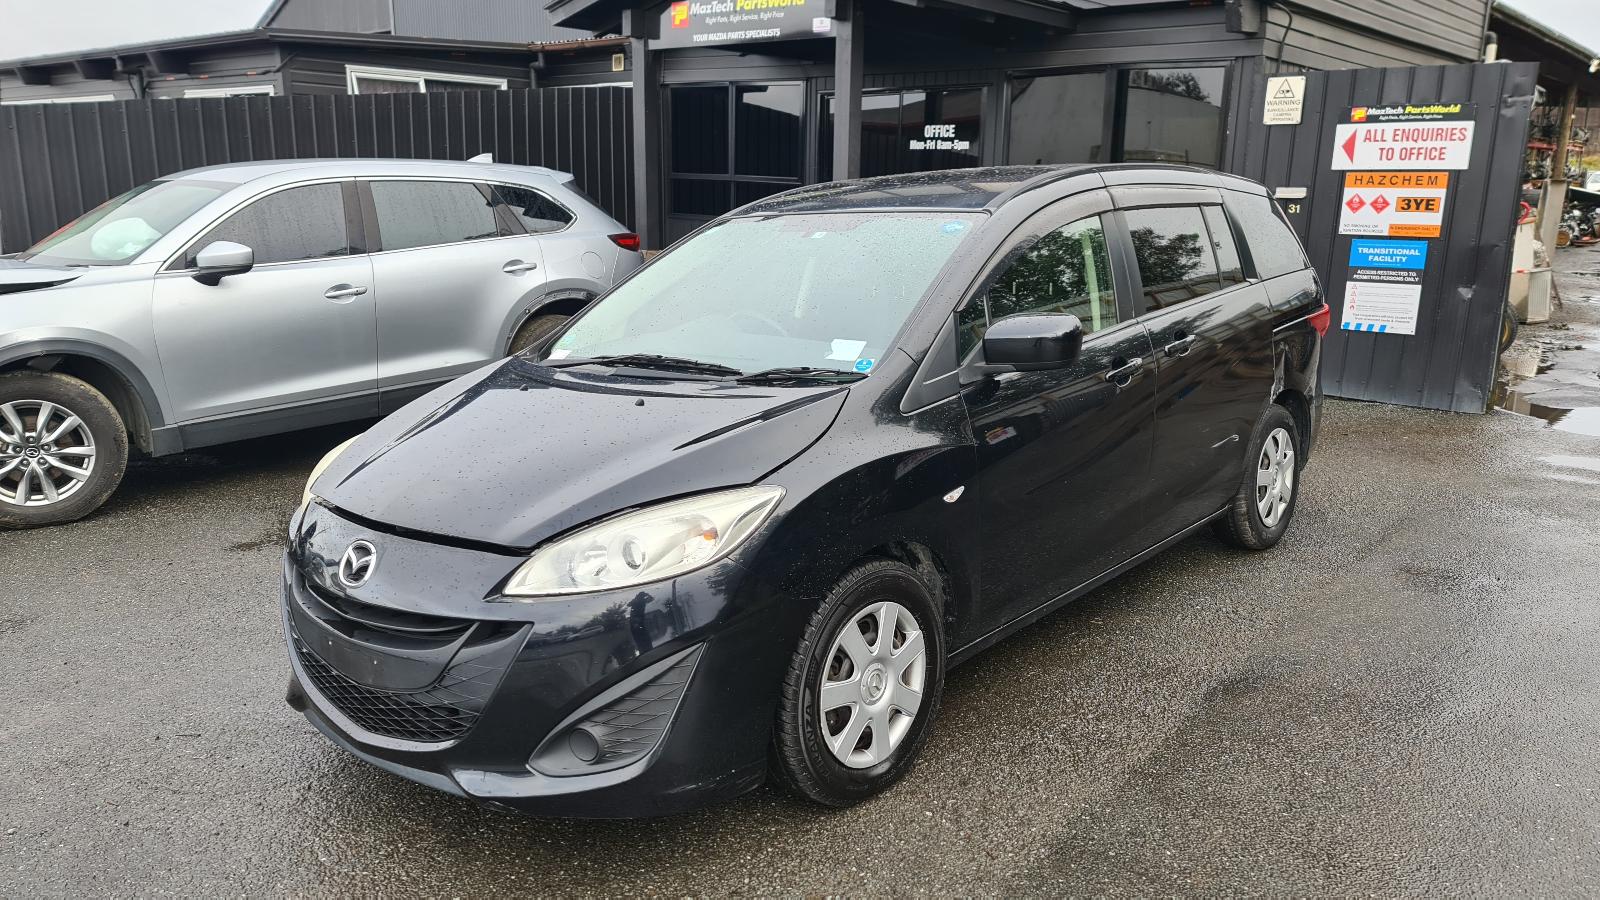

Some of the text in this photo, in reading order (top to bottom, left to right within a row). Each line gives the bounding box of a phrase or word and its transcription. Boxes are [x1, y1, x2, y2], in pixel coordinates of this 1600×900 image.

[690, 0, 733, 15] MazTech
[693, 28, 781, 42] YOUR MAZDA PARTS SPECIALISTS
[1367, 103, 1462, 115] MazTech PartsWorld
[924, 124, 956, 138] OFFICE
[1363, 127, 1468, 143] ALL ENQUIRIES
[909, 139, 970, 151] Mon-Fri 8am-5pm
[1378, 146, 1447, 161] TO OFFICE
[1354, 175, 1439, 186] HAZCHEM
[1288, 203, 1301, 214] 31
[1400, 198, 1436, 211] 3YE
[1357, 247, 1421, 255] TRANSITIONAL
[1368, 255, 1408, 263] FACILITY
